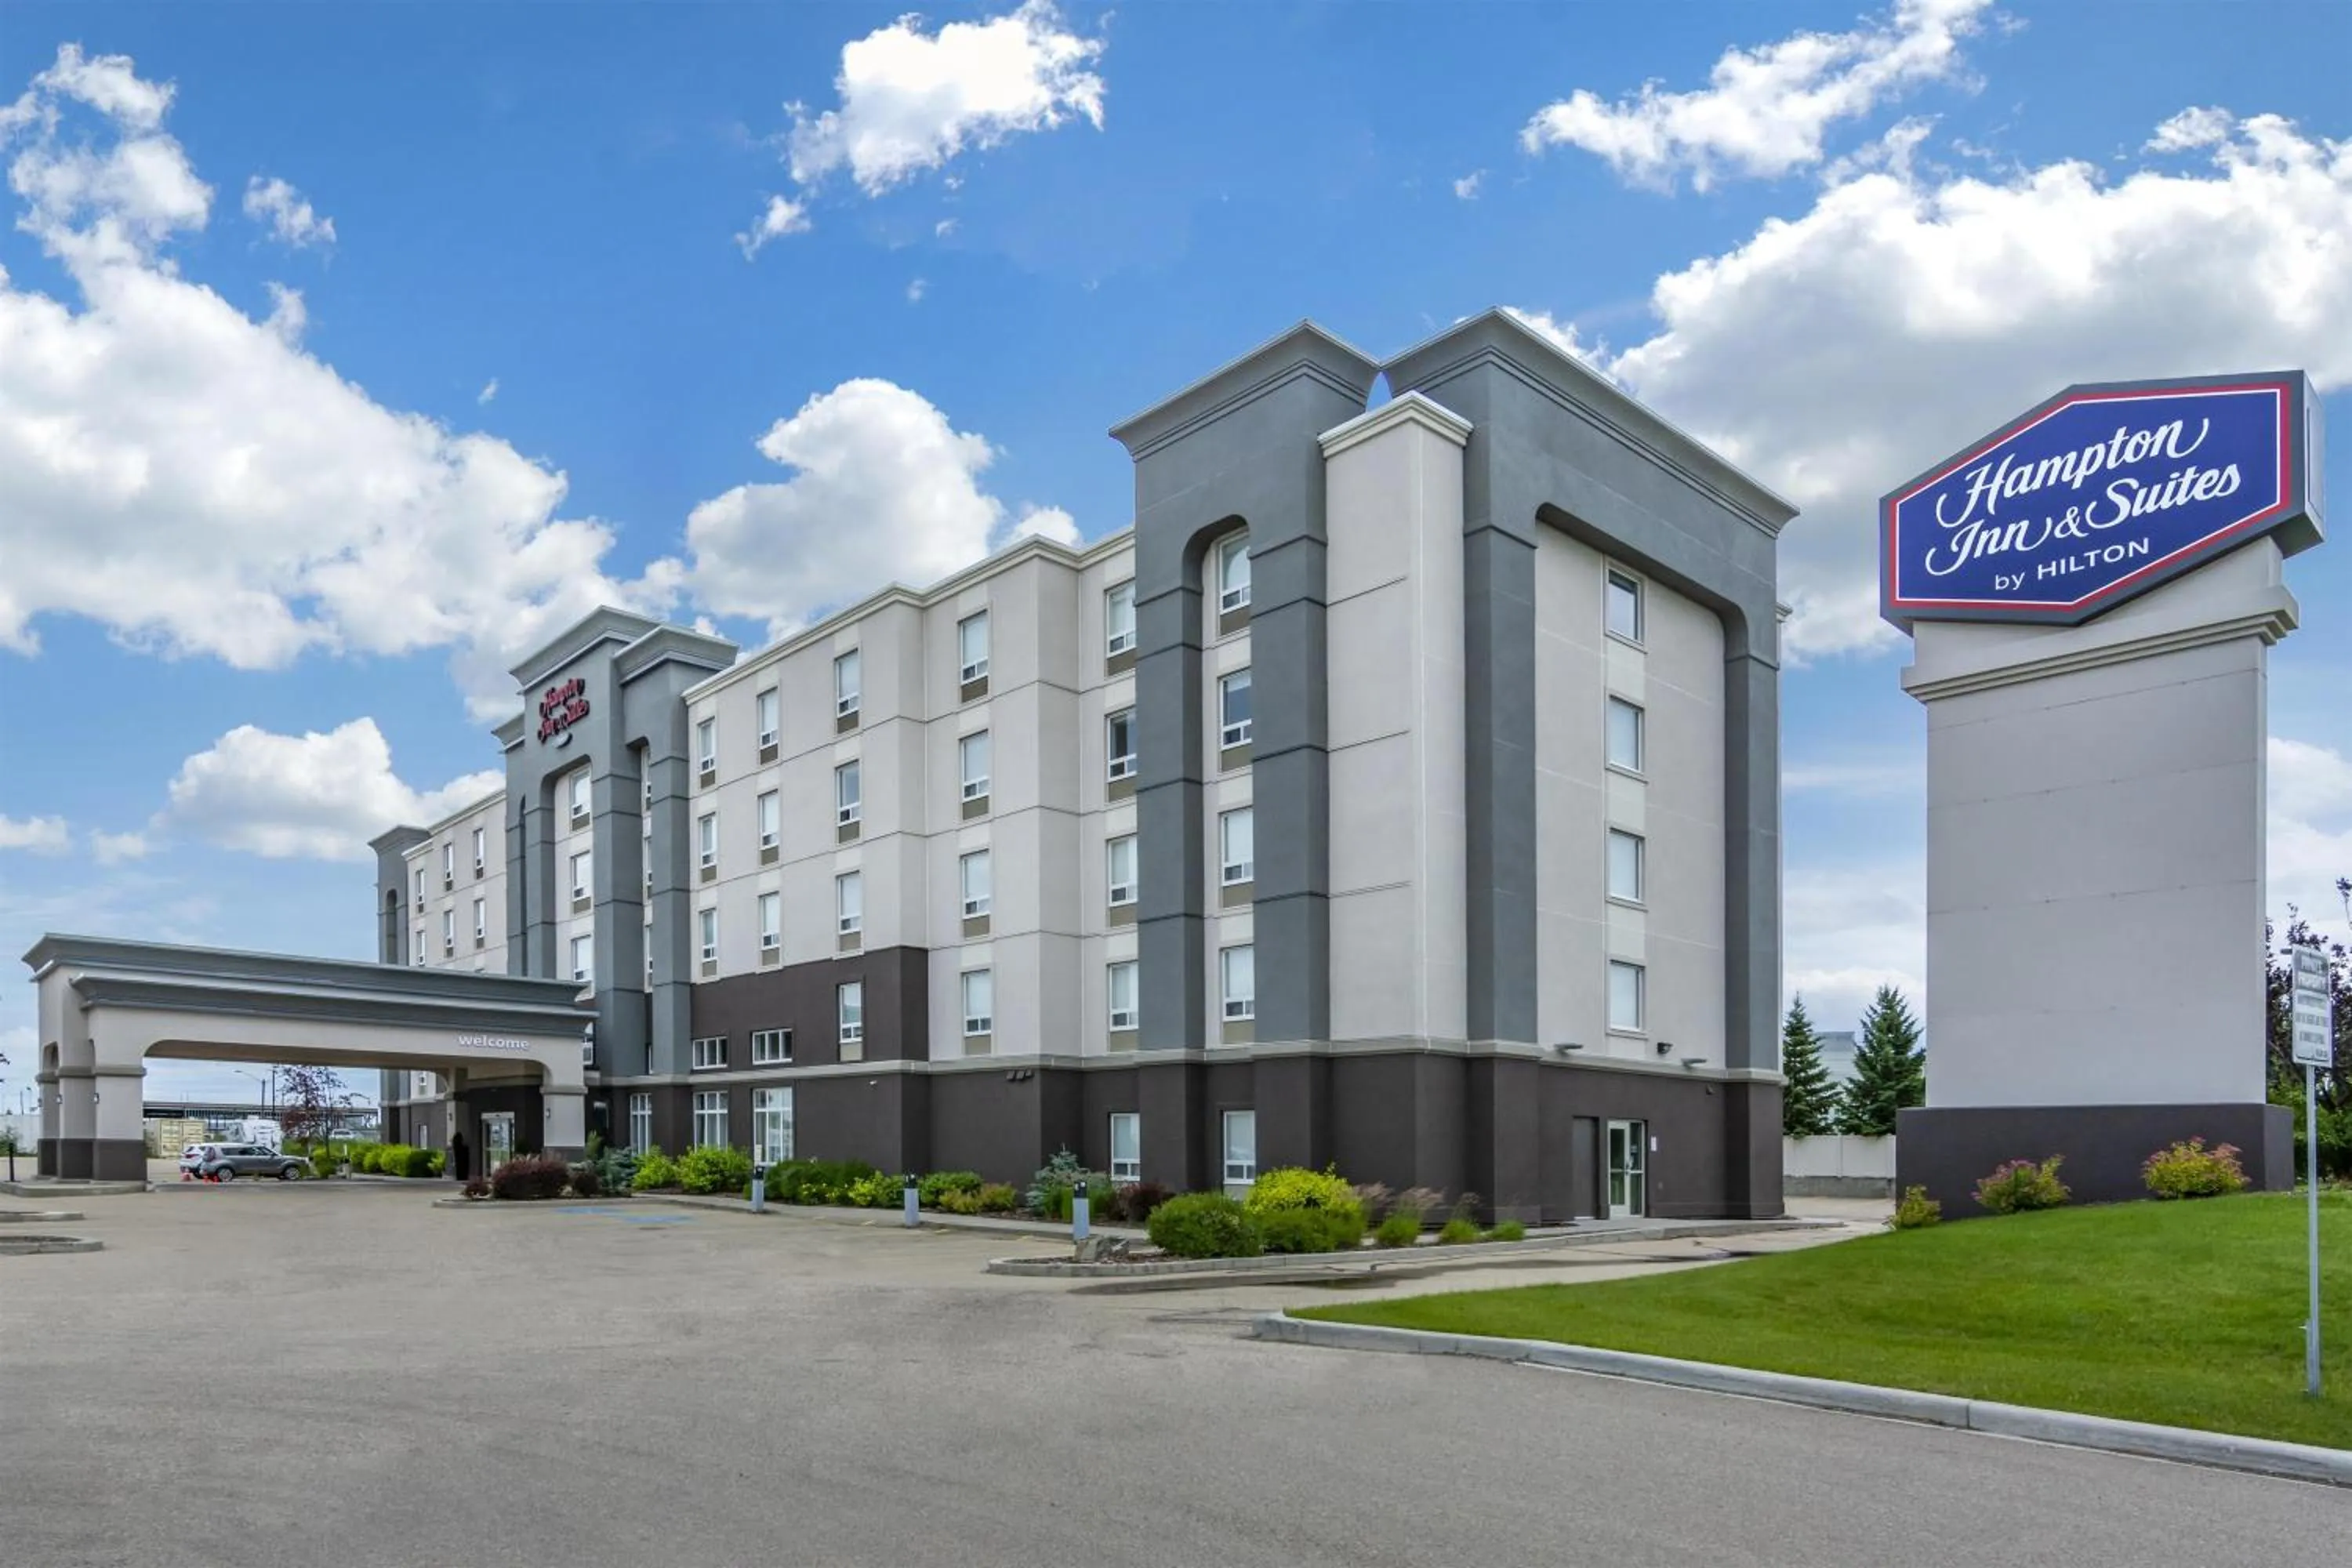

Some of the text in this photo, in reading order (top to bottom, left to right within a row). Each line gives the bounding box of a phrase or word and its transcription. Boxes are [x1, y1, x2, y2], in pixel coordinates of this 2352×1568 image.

[1926, 463, 2241, 576] Inn & Suites
[1936, 418, 2210, 528] Hampton
[1994, 537, 2149, 590] by HILTON
